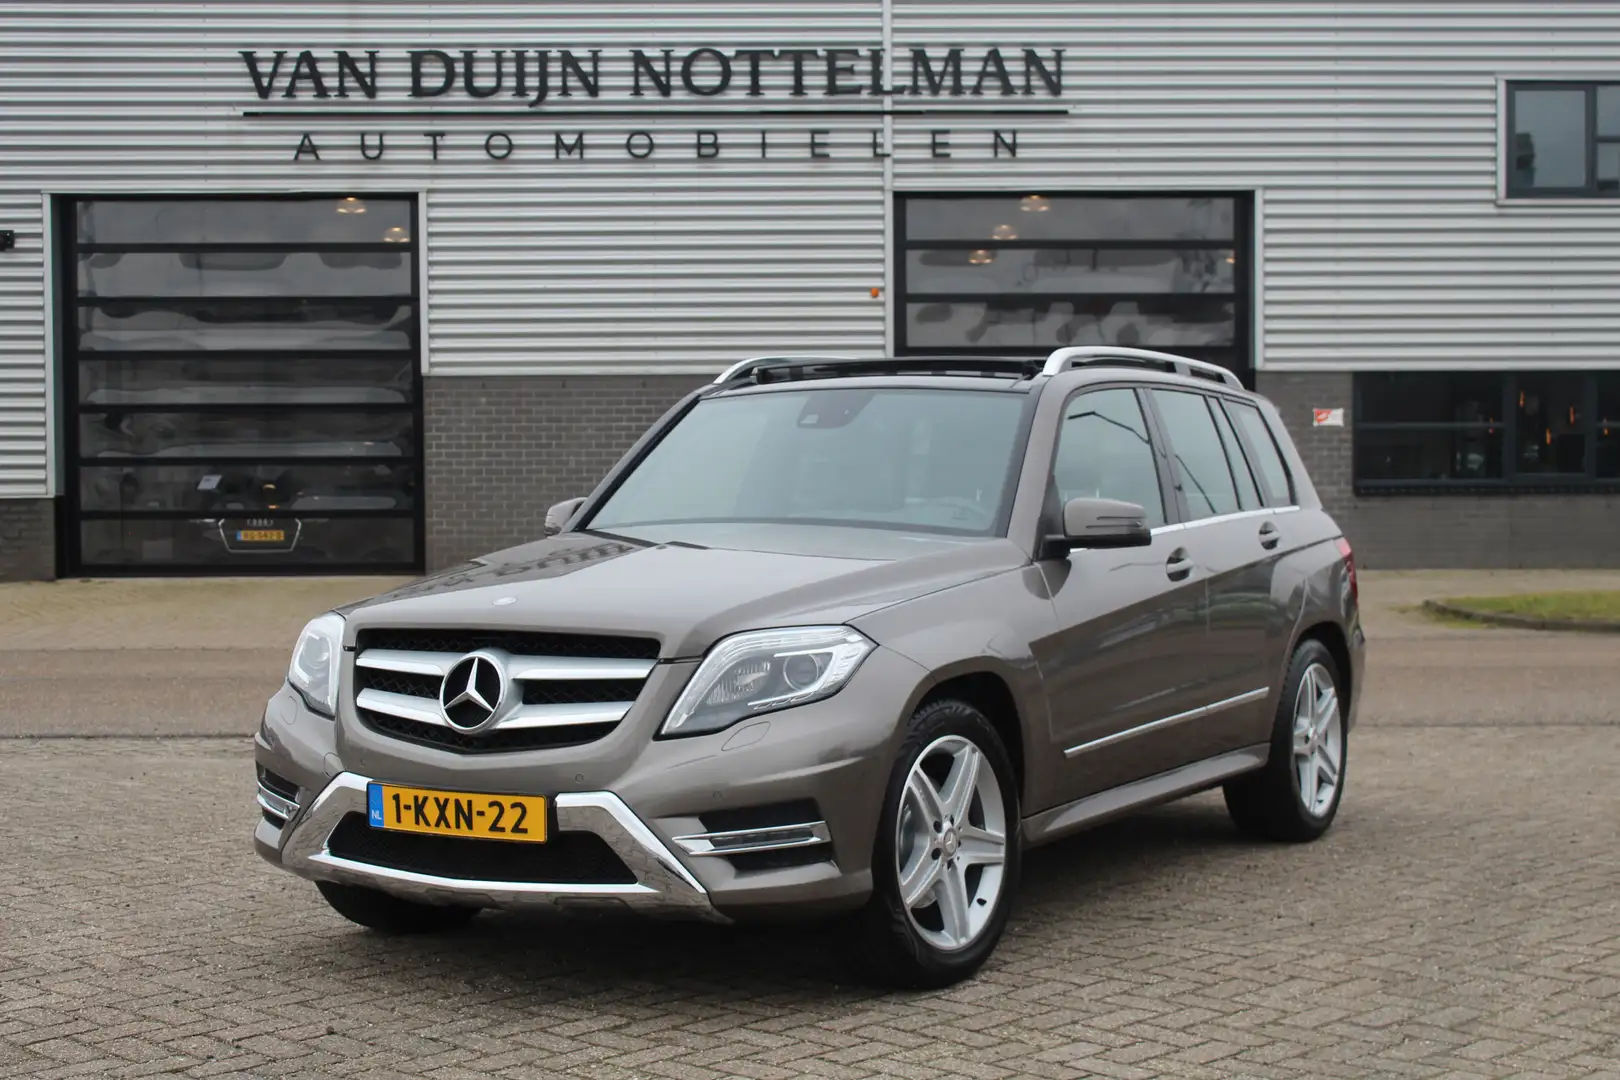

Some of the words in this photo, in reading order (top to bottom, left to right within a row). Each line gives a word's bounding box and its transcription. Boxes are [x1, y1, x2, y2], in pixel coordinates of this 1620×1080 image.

[238, 49, 380, 99] VAN
[405, 48, 602, 108] DUIJN
[629, 47, 1066, 98] NOTTELMAN
[293, 131, 1018, 161] AUTOMOBILEN
[371, 810, 382, 821] NL
[392, 793, 528, 834] 1-KXN-22
